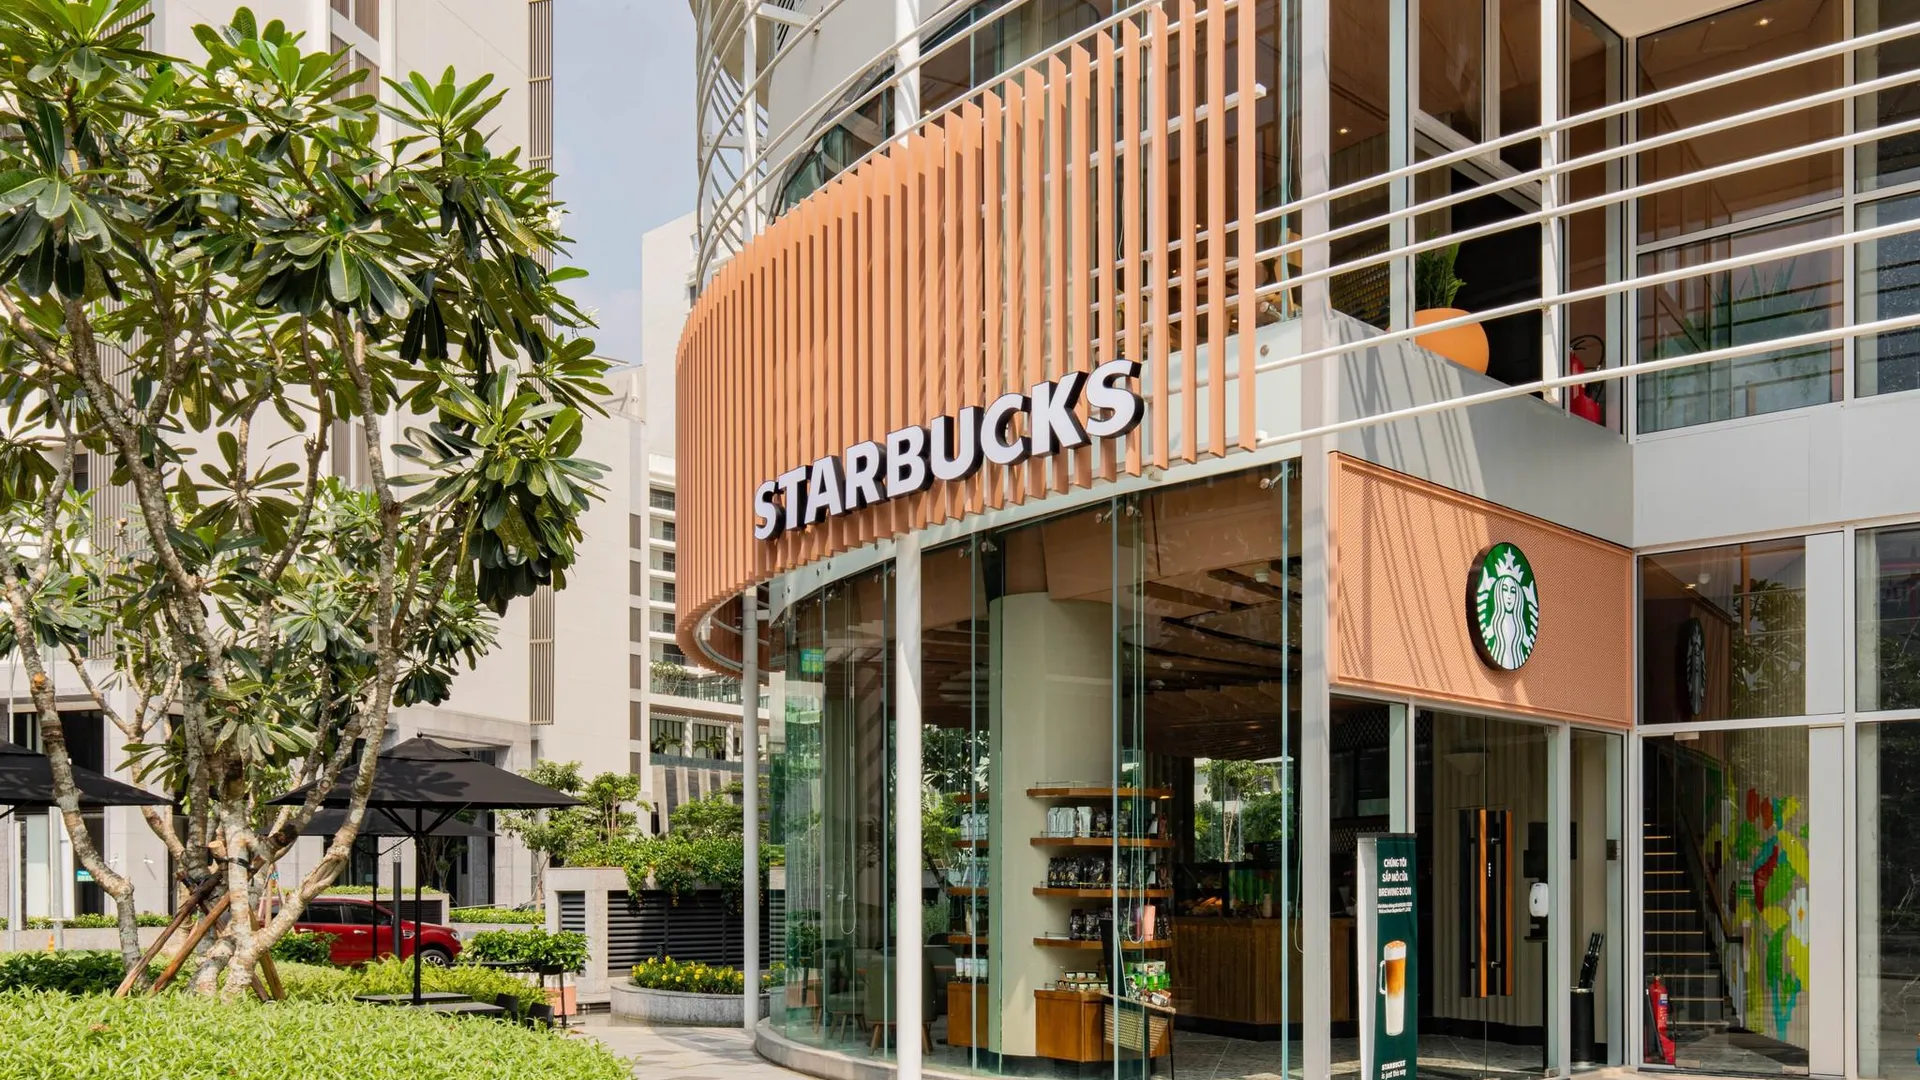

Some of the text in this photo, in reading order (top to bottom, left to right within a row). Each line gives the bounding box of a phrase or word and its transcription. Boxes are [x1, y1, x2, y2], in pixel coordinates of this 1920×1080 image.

[754, 359, 1144, 541] STARBUCKS
[1378, 886, 1411, 897] BREWING SOON
[1381, 1060, 1406, 1071] STARBUCKS
